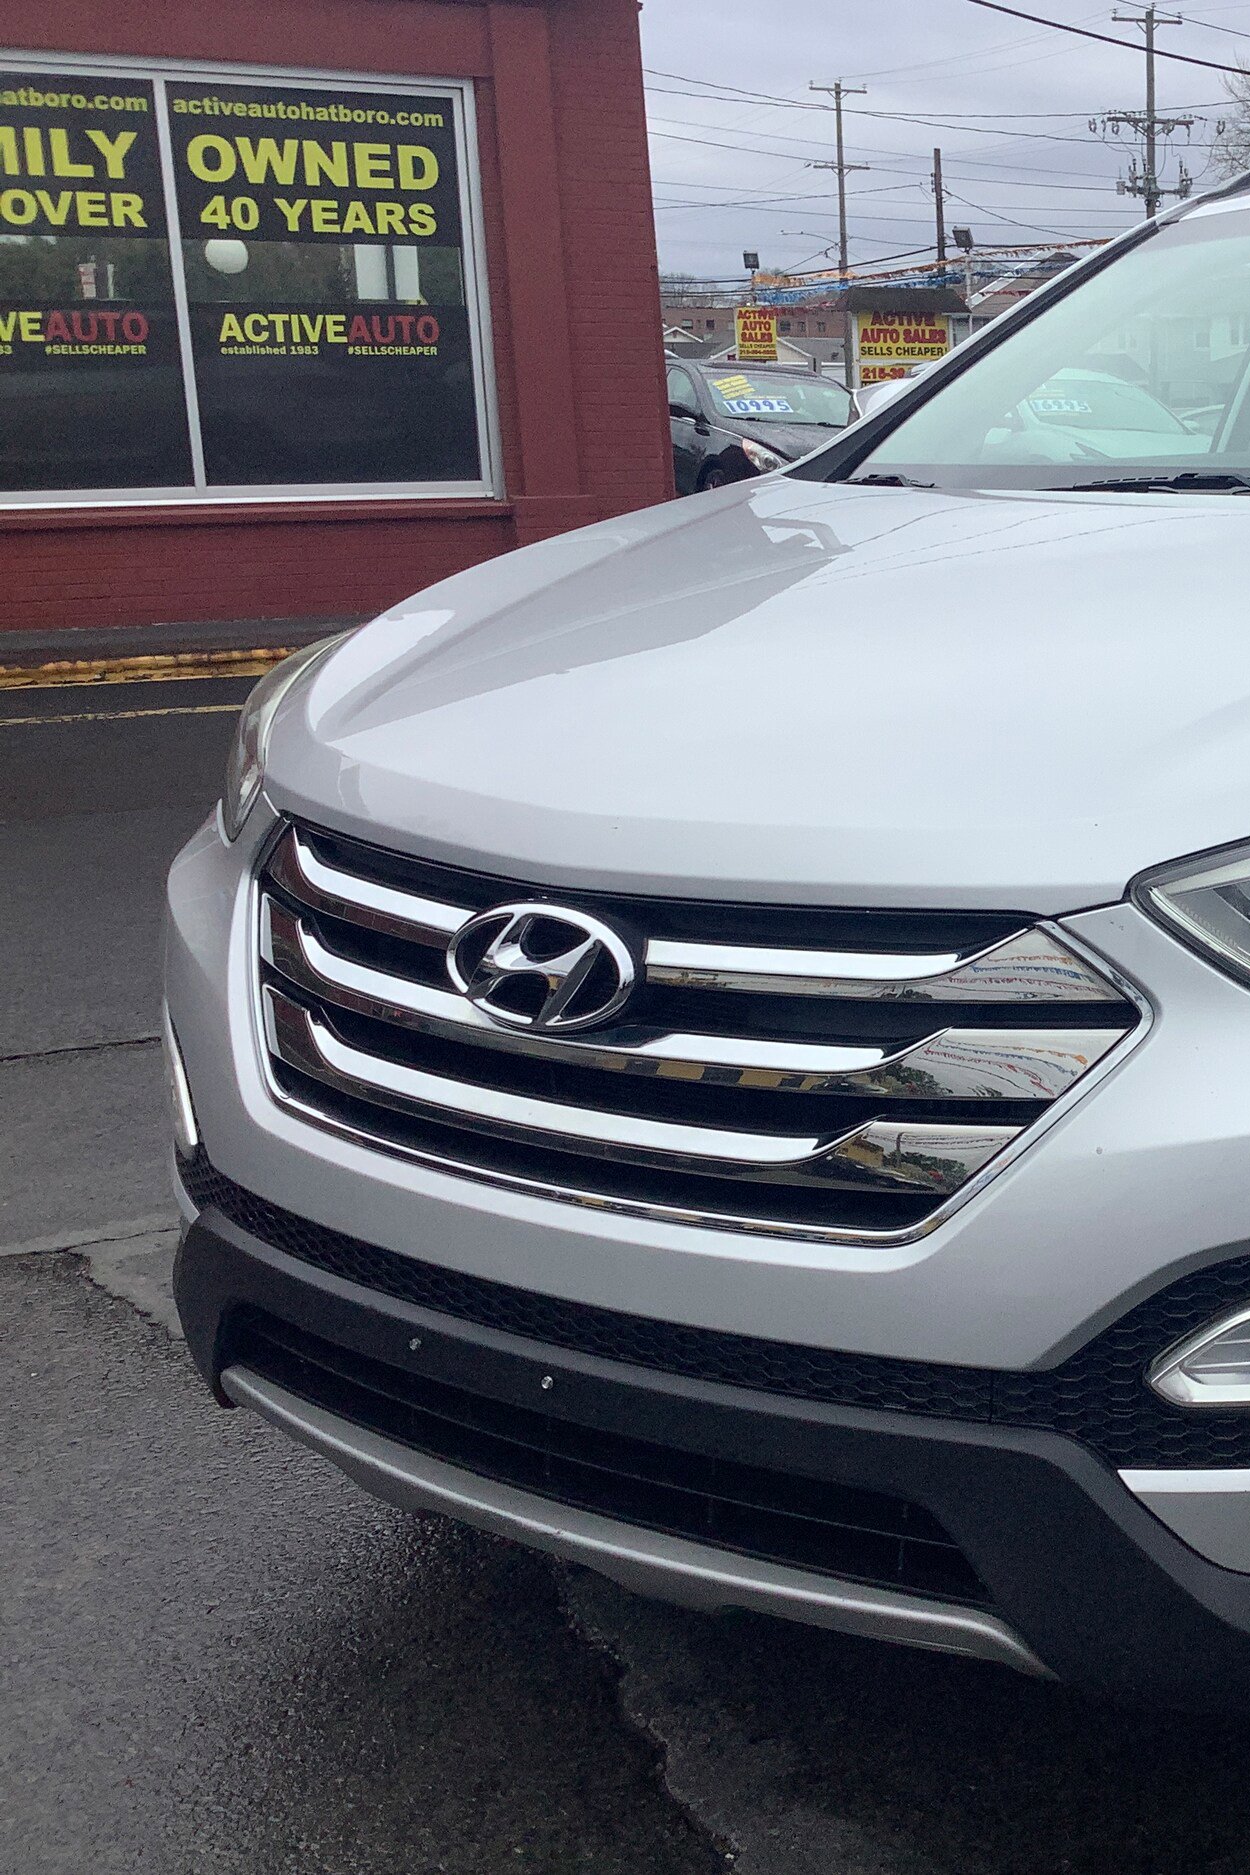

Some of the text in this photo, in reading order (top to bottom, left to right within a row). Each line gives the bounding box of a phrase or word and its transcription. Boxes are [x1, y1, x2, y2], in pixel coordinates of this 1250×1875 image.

[173, 96, 445, 128] activeautohatboro.com
[187, 134, 440, 191] OWNED
[0, 188, 438, 237] OVER 40 YEARS
[870, 310, 936, 327] ACTIVE
[742, 320, 771, 331] AUTO
[741, 332, 773, 343] SALES
[860, 328, 947, 344] AUTO SALES
[45, 344, 147, 355] #SELLSCHEAPER
[220, 346, 438, 356] established 1983 #SELLSCHEAPER
[860, 346, 948, 356] SELLS CHEAPER!
[862, 367, 907, 379] 215-39
[725, 400, 790, 413] 10995
